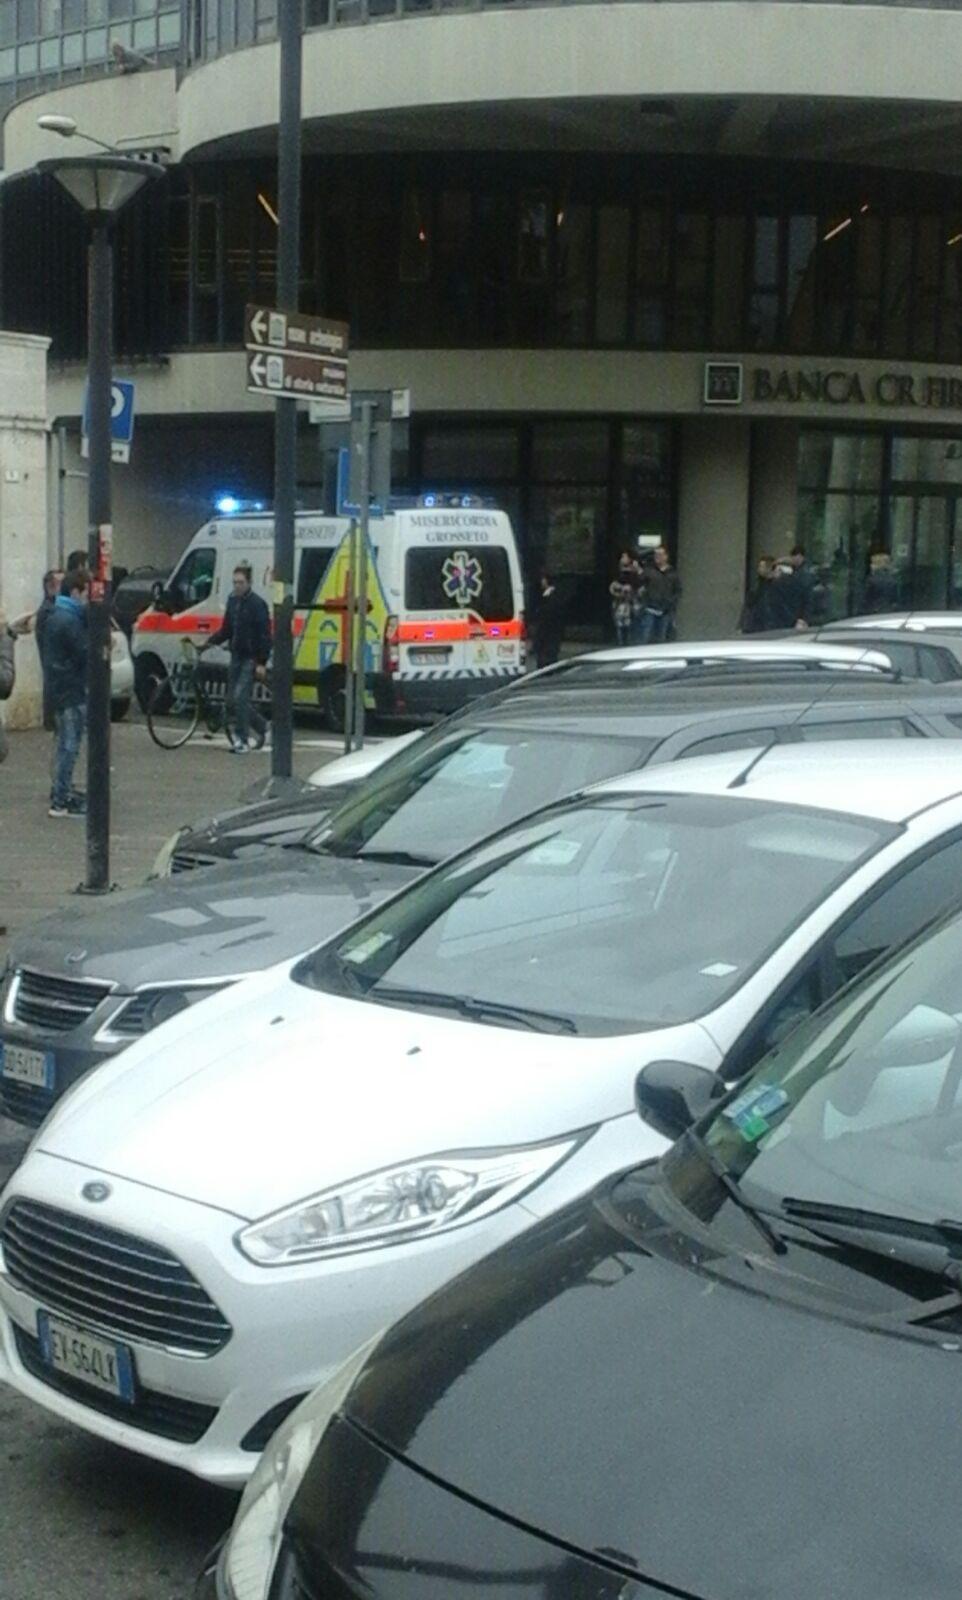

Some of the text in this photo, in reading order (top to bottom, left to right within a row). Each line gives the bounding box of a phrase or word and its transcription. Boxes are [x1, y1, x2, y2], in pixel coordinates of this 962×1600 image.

[753, 367, 865, 403] BANCA
[409, 514, 498, 528] MISERICORDIA
[425, 531, 488, 543] GROSSETO
